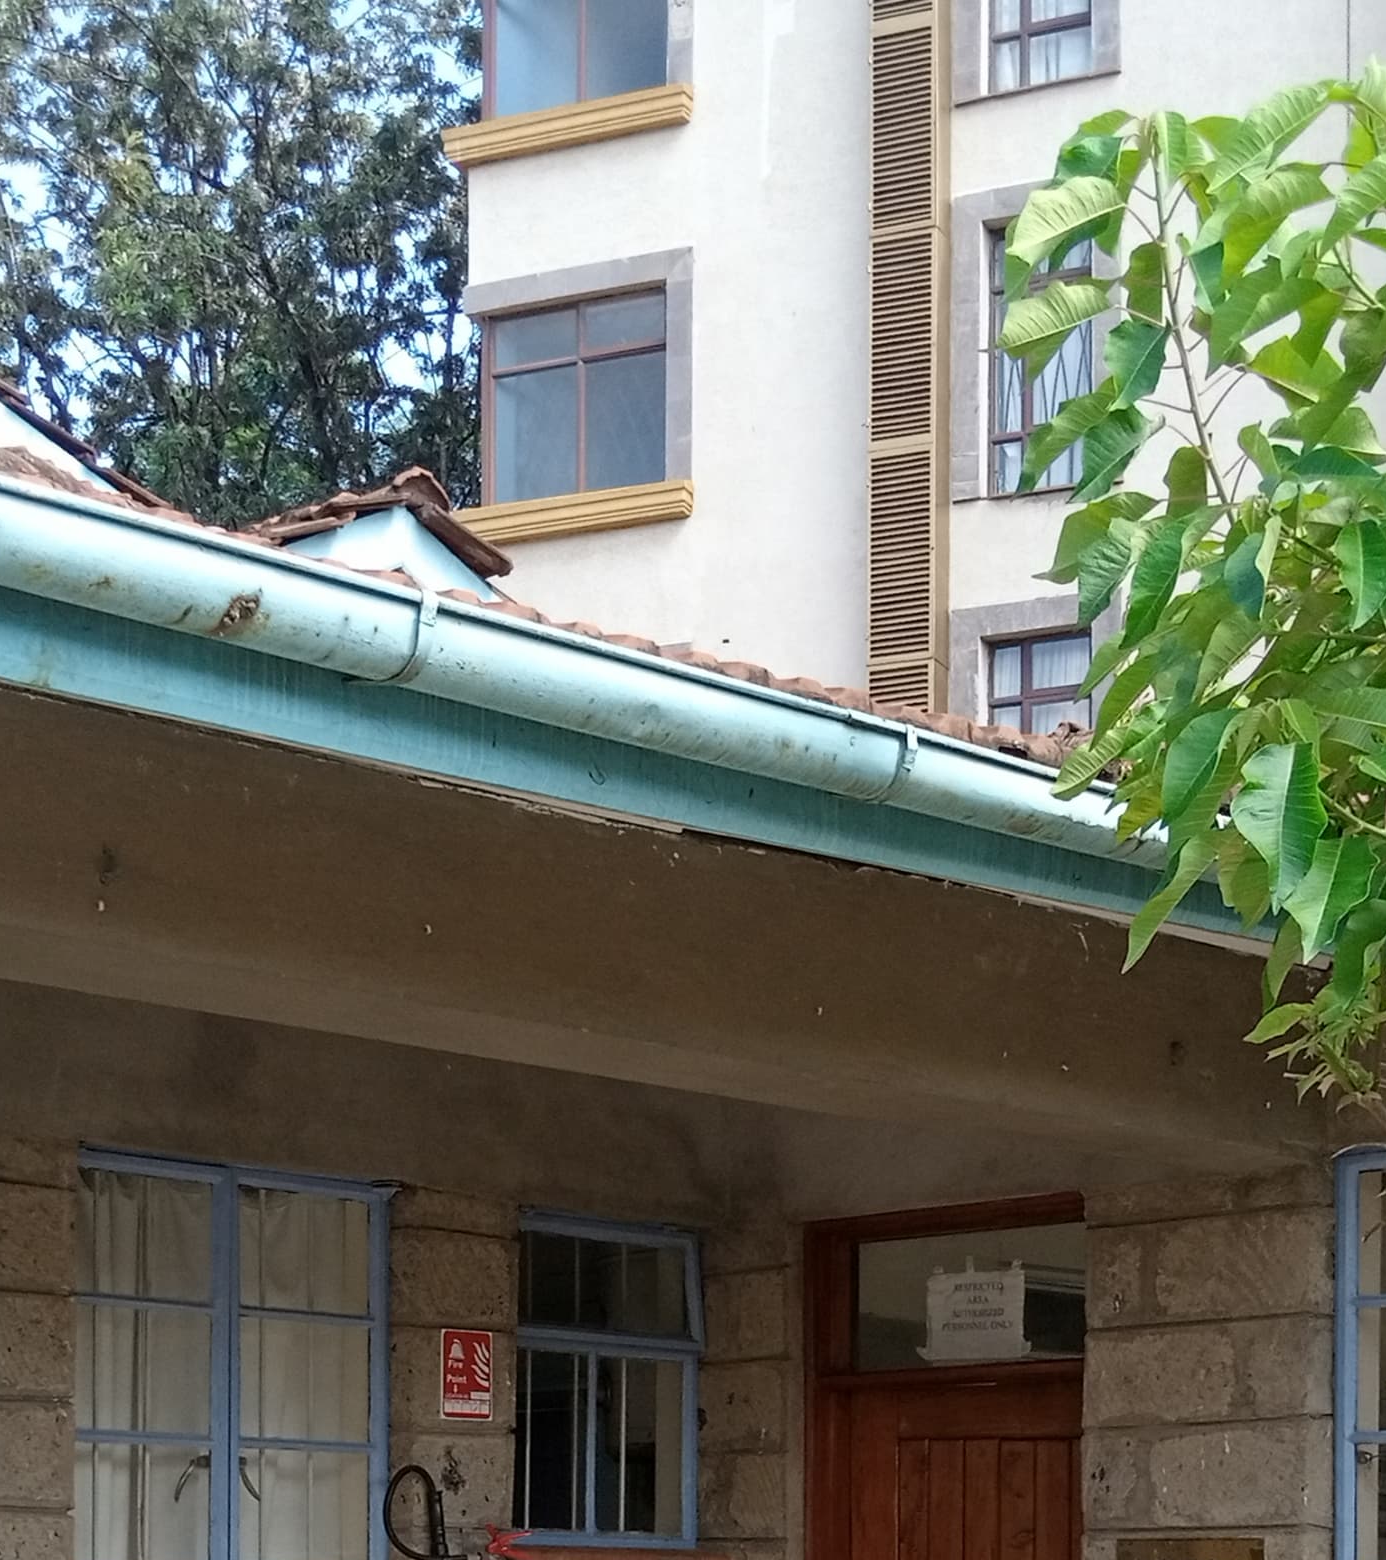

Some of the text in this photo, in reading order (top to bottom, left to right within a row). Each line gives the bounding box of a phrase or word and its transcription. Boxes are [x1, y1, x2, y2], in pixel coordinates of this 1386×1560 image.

[966, 1295, 990, 1304] AREA
[447, 1359, 464, 1369] Fire
[446, 1373, 467, 1384] Point
